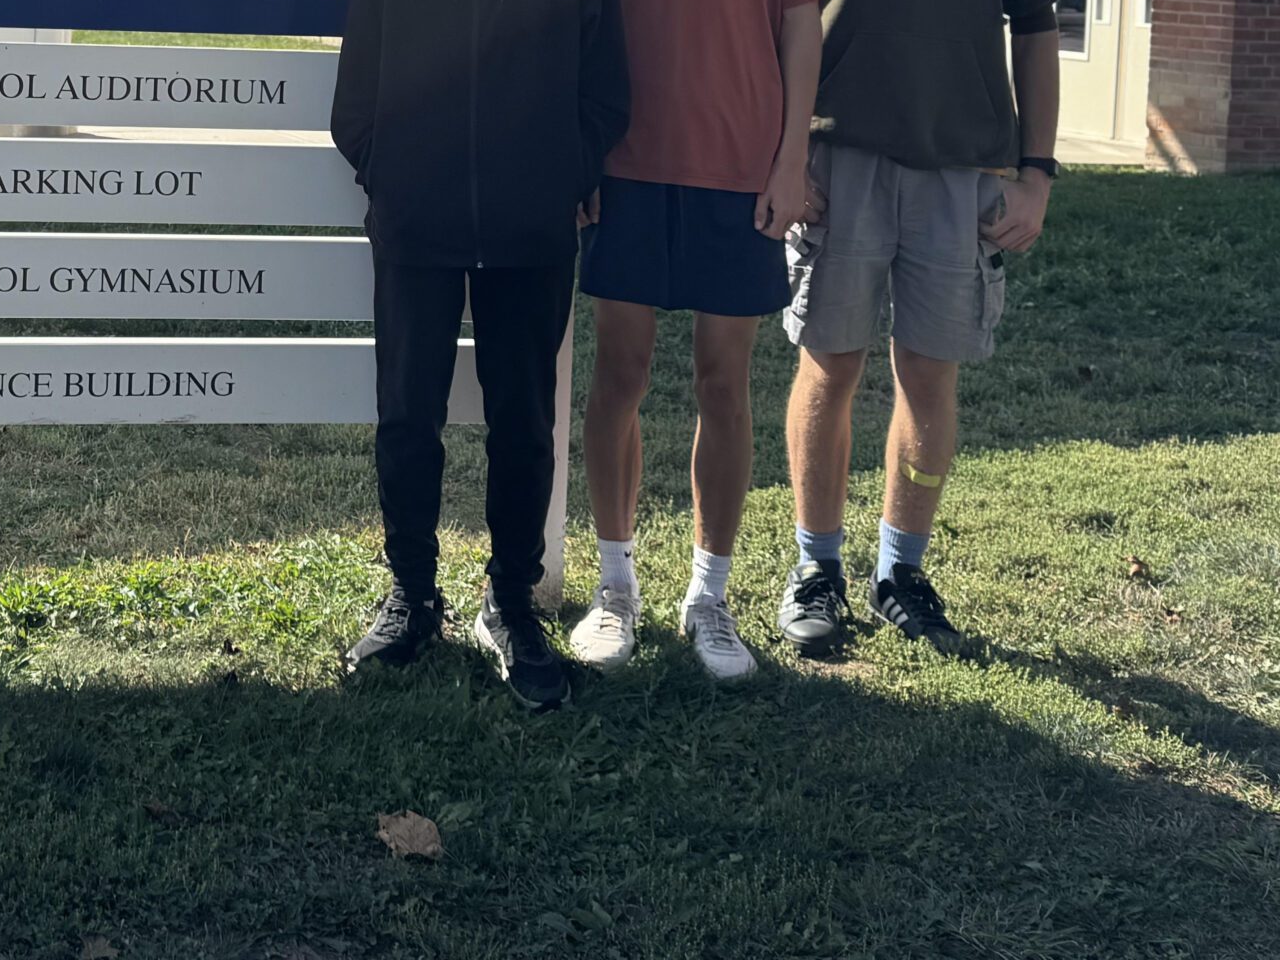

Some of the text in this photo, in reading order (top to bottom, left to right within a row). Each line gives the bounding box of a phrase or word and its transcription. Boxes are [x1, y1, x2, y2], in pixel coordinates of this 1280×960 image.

[55, 74, 288, 105] AUDITORIUM
[133, 170, 203, 197] LOT
[49, 267, 266, 295] GYMNASIUM
[63, 371, 236, 398] BUILDING
